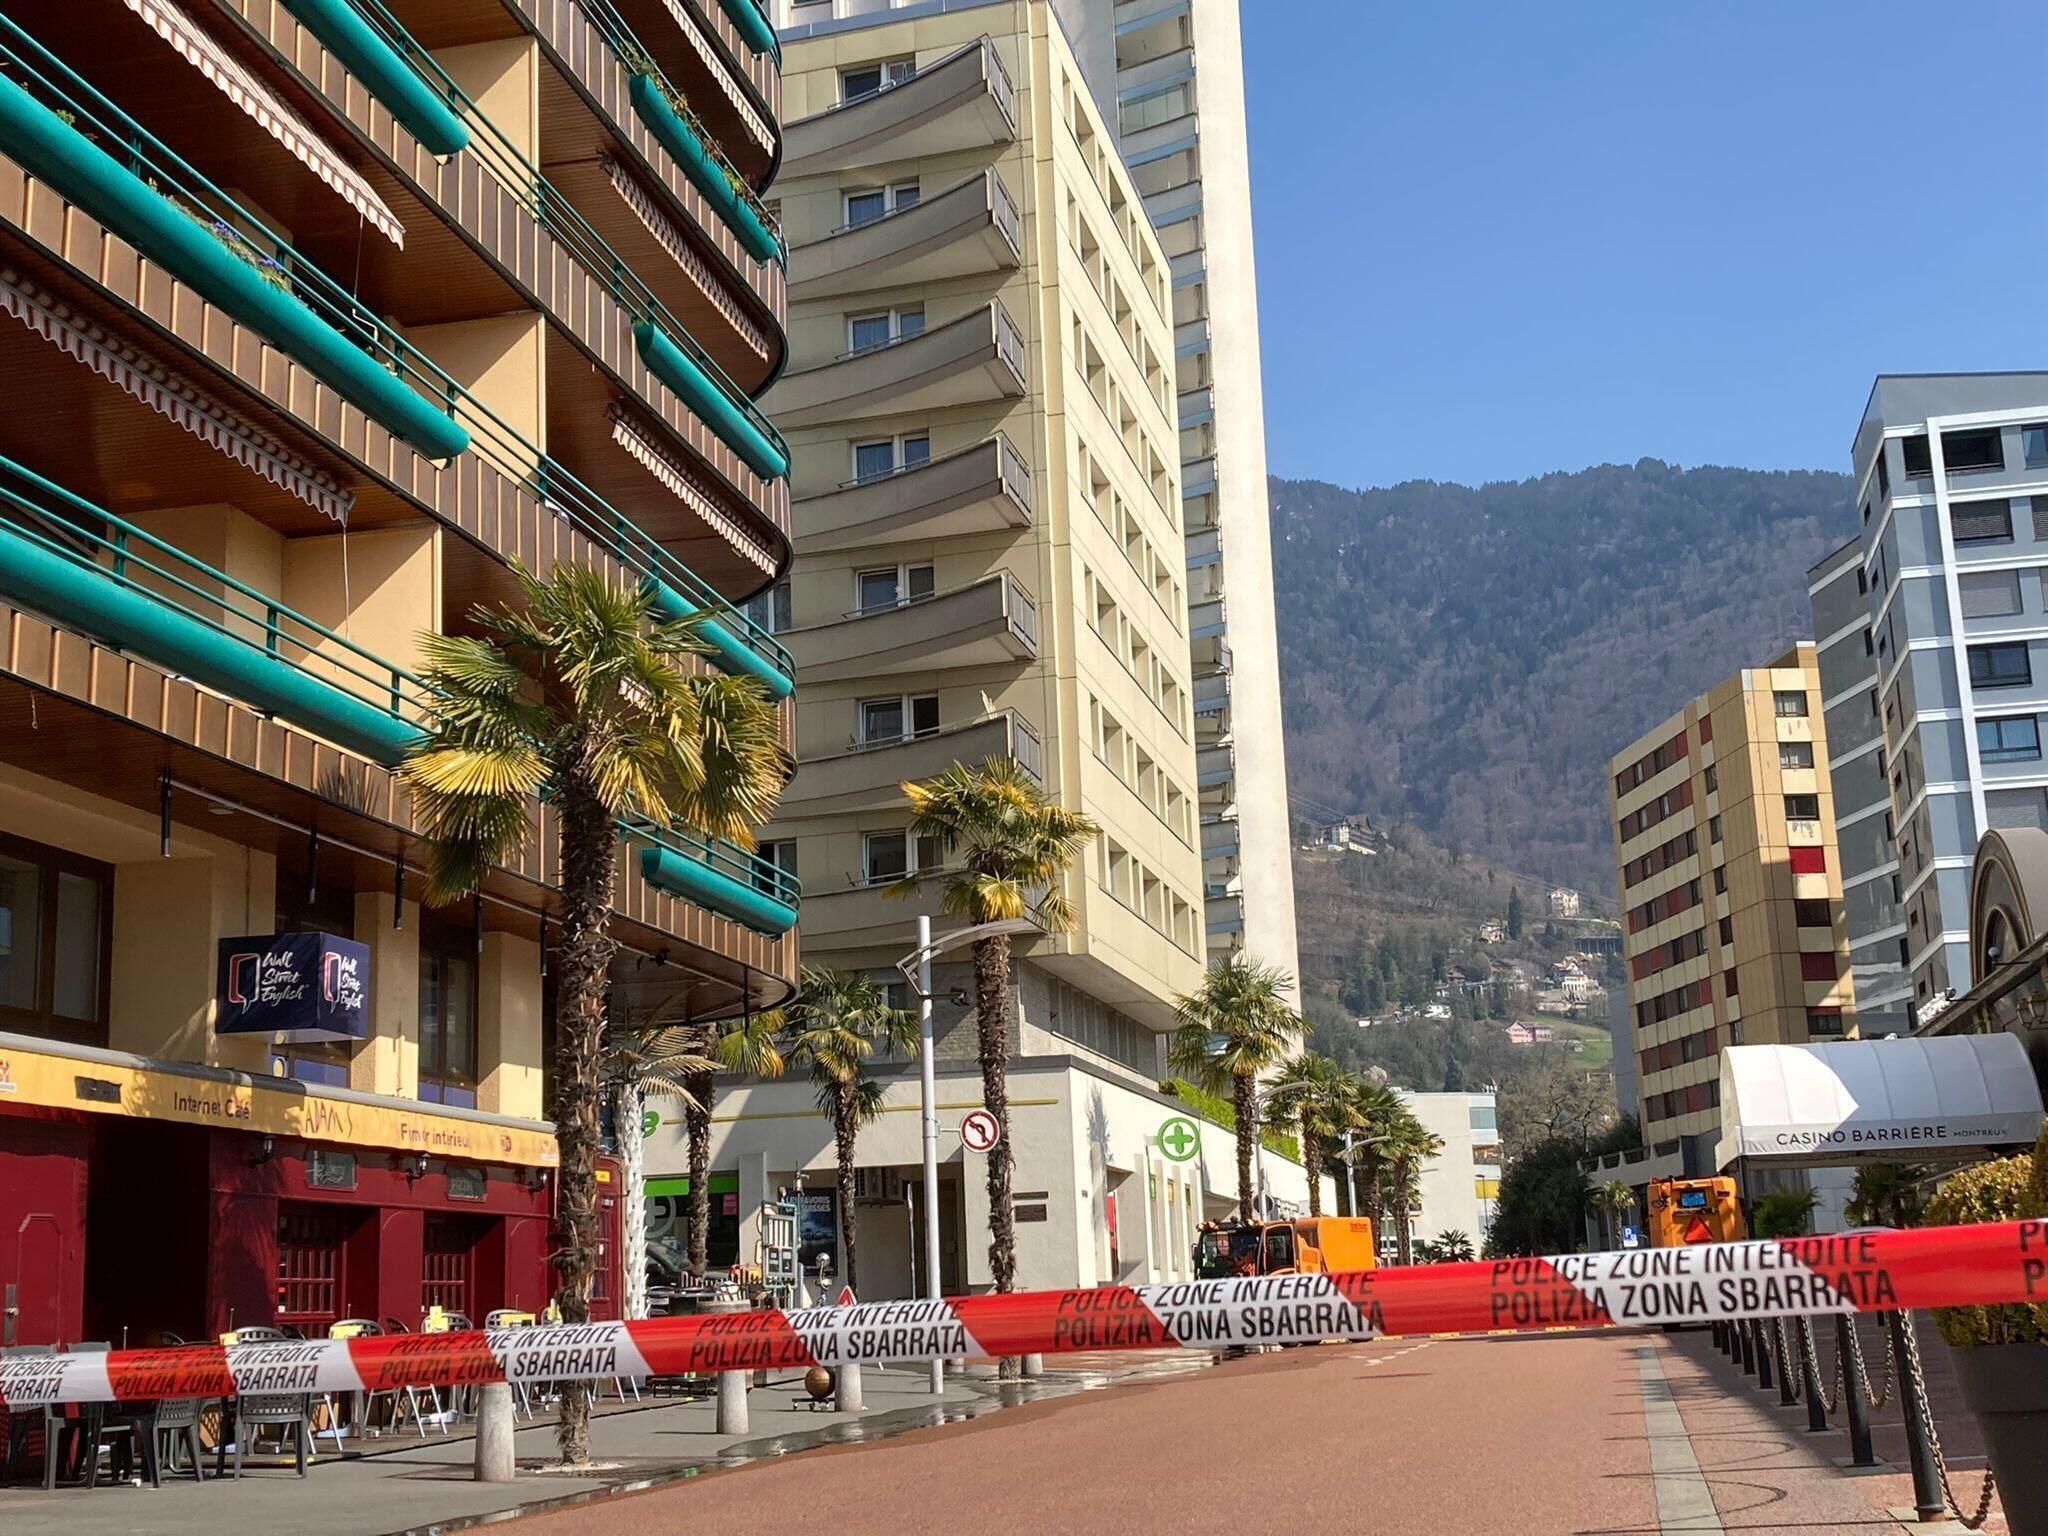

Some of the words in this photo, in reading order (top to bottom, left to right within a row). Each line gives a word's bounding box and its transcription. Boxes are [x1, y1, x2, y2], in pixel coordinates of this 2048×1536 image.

[261, 968, 302, 985] Street
[262, 951, 293, 968] Wall
[261, 985, 305, 1007] English
[1776, 1130, 1847, 1146] CASINO
[1491, 1256, 1598, 1286] POLICE
[1608, 1249, 1692, 1280] ZONE
[1704, 1234, 1877, 1273] INTERDITE
[1056, 1286, 1150, 1314] POLICE
[1153, 1281, 1228, 1308] ZONE
[1232, 1271, 1378, 1303] INTERDITE
[1490, 1286, 1611, 1325] POLIZIA
[1620, 1281, 1709, 1318] ZONA
[1719, 1269, 1898, 1313] SBARRATA
[696, 1312, 777, 1337] POLICE
[779, 1308, 844, 1333] ZONE
[843, 1299, 968, 1328] INTERDITE
[1054, 1313, 1154, 1348] POLIZIA
[1160, 1309, 1232, 1342] ZONA
[1241, 1299, 1385, 1338] SBARRATA
[231, 1345, 330, 1366] INTERDITE
[388, 1336, 457, 1355] POLICE
[461, 1331, 513, 1350] ZONE
[514, 1325, 625, 1349] INTERDITE
[689, 1337, 773, 1369] POLIZIA
[779, 1331, 839, 1363] ZONA
[849, 1324, 967, 1359] SBARRATA
[113, 1373, 177, 1397] POLIZIA
[178, 1370, 225, 1394] ZONA
[230, 1364, 320, 1391] SBARRATA
[378, 1356, 450, 1385] POLIZIA
[455, 1352, 507, 1381] ZONA
[513, 1346, 617, 1378] SBARRATA
